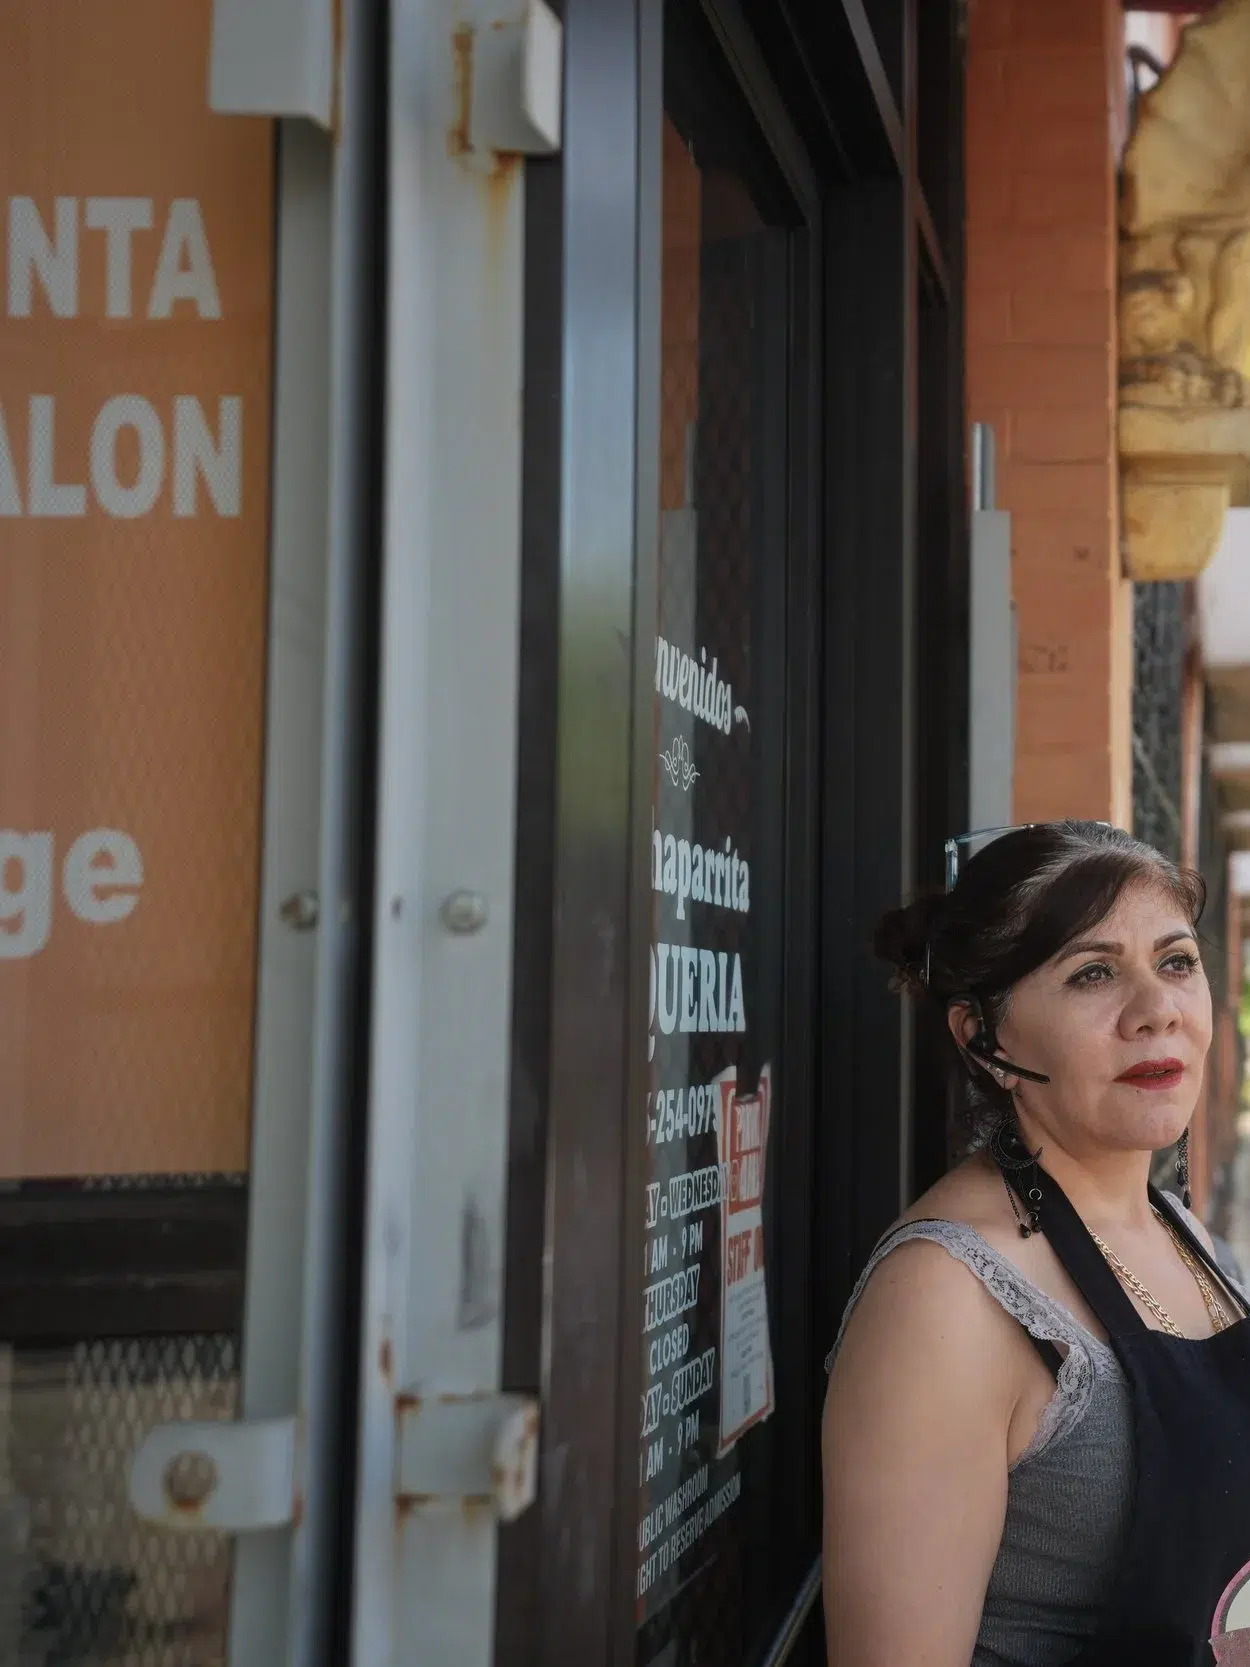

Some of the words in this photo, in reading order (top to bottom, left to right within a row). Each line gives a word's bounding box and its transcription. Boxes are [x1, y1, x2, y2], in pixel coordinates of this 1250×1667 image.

[7, 197, 222, 320] NTA
[647, 942, 746, 1063] UERIA
[651, 1234, 668, 1274] AM
[681, 1226, 687, 1260] 9
[689, 1220, 704, 1256] PM
[649, 1322, 690, 1376] CLOSED
[671, 1347, 716, 1415] SUNDAY
[646, 1436, 664, 1482] AM
[678, 1421, 684, 1456] 9
[685, 1408, 699, 1449] PM
[665, 1463, 709, 1528] WASHROOM
[658, 1541, 669, 1576] TO
[670, 1507, 704, 1565] RESERVE
